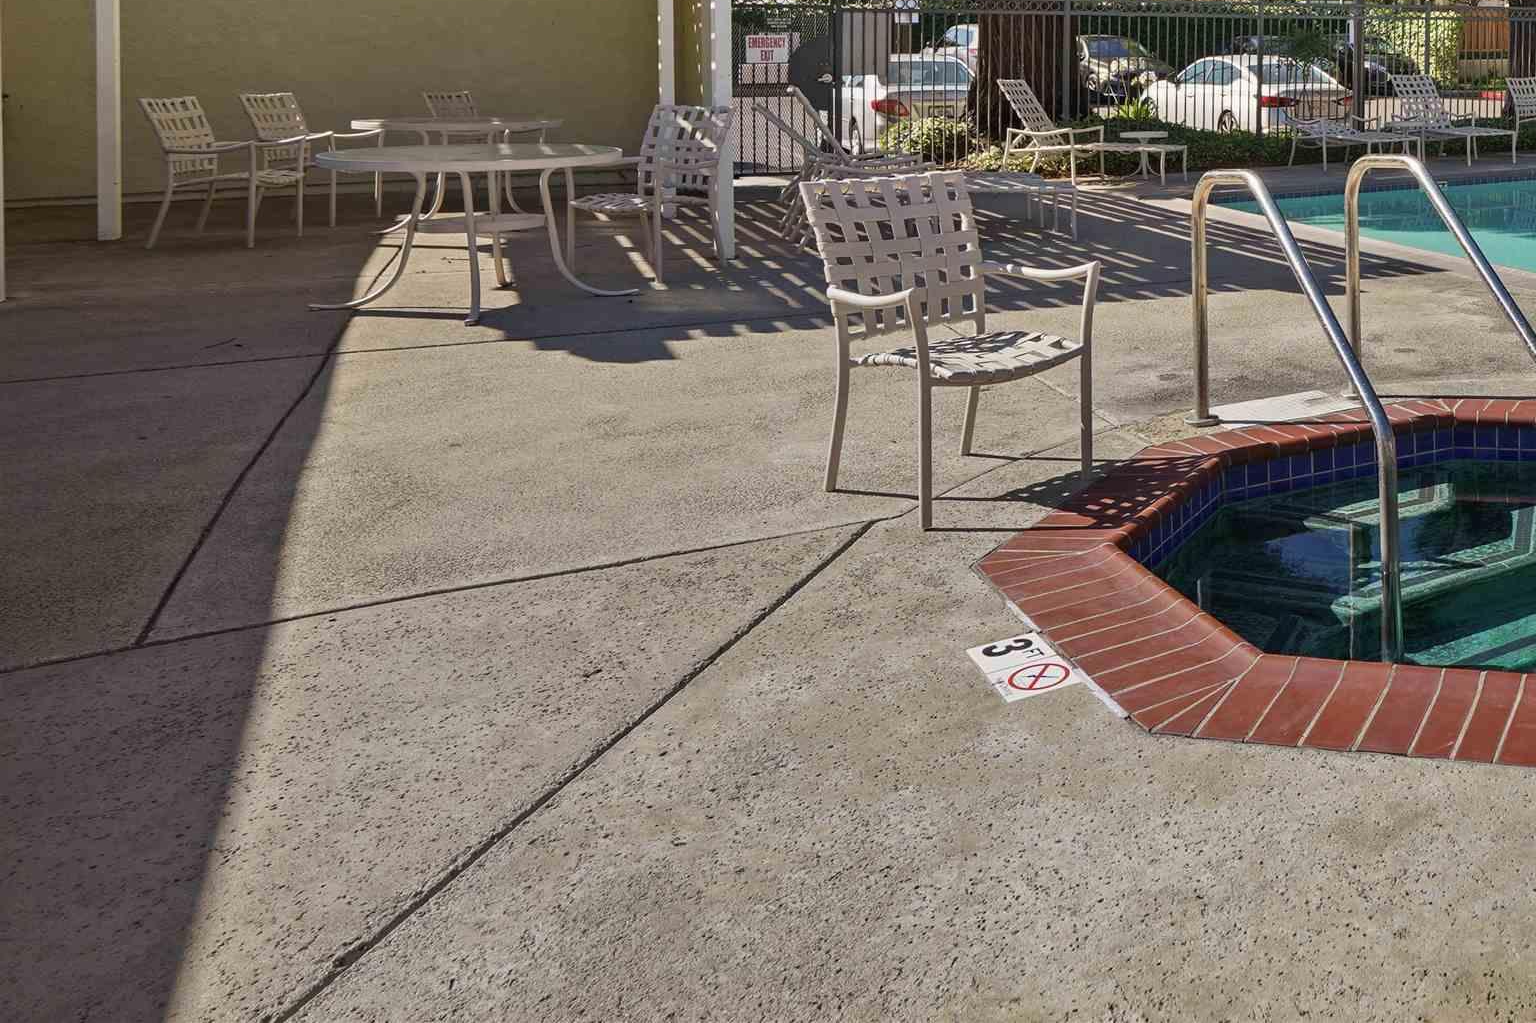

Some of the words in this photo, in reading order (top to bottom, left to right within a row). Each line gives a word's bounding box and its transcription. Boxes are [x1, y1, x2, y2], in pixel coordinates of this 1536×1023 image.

[748, 37, 786, 49] EMERGENCY
[760, 50, 775, 62] EXIT
[982, 638, 1033, 657] 3
